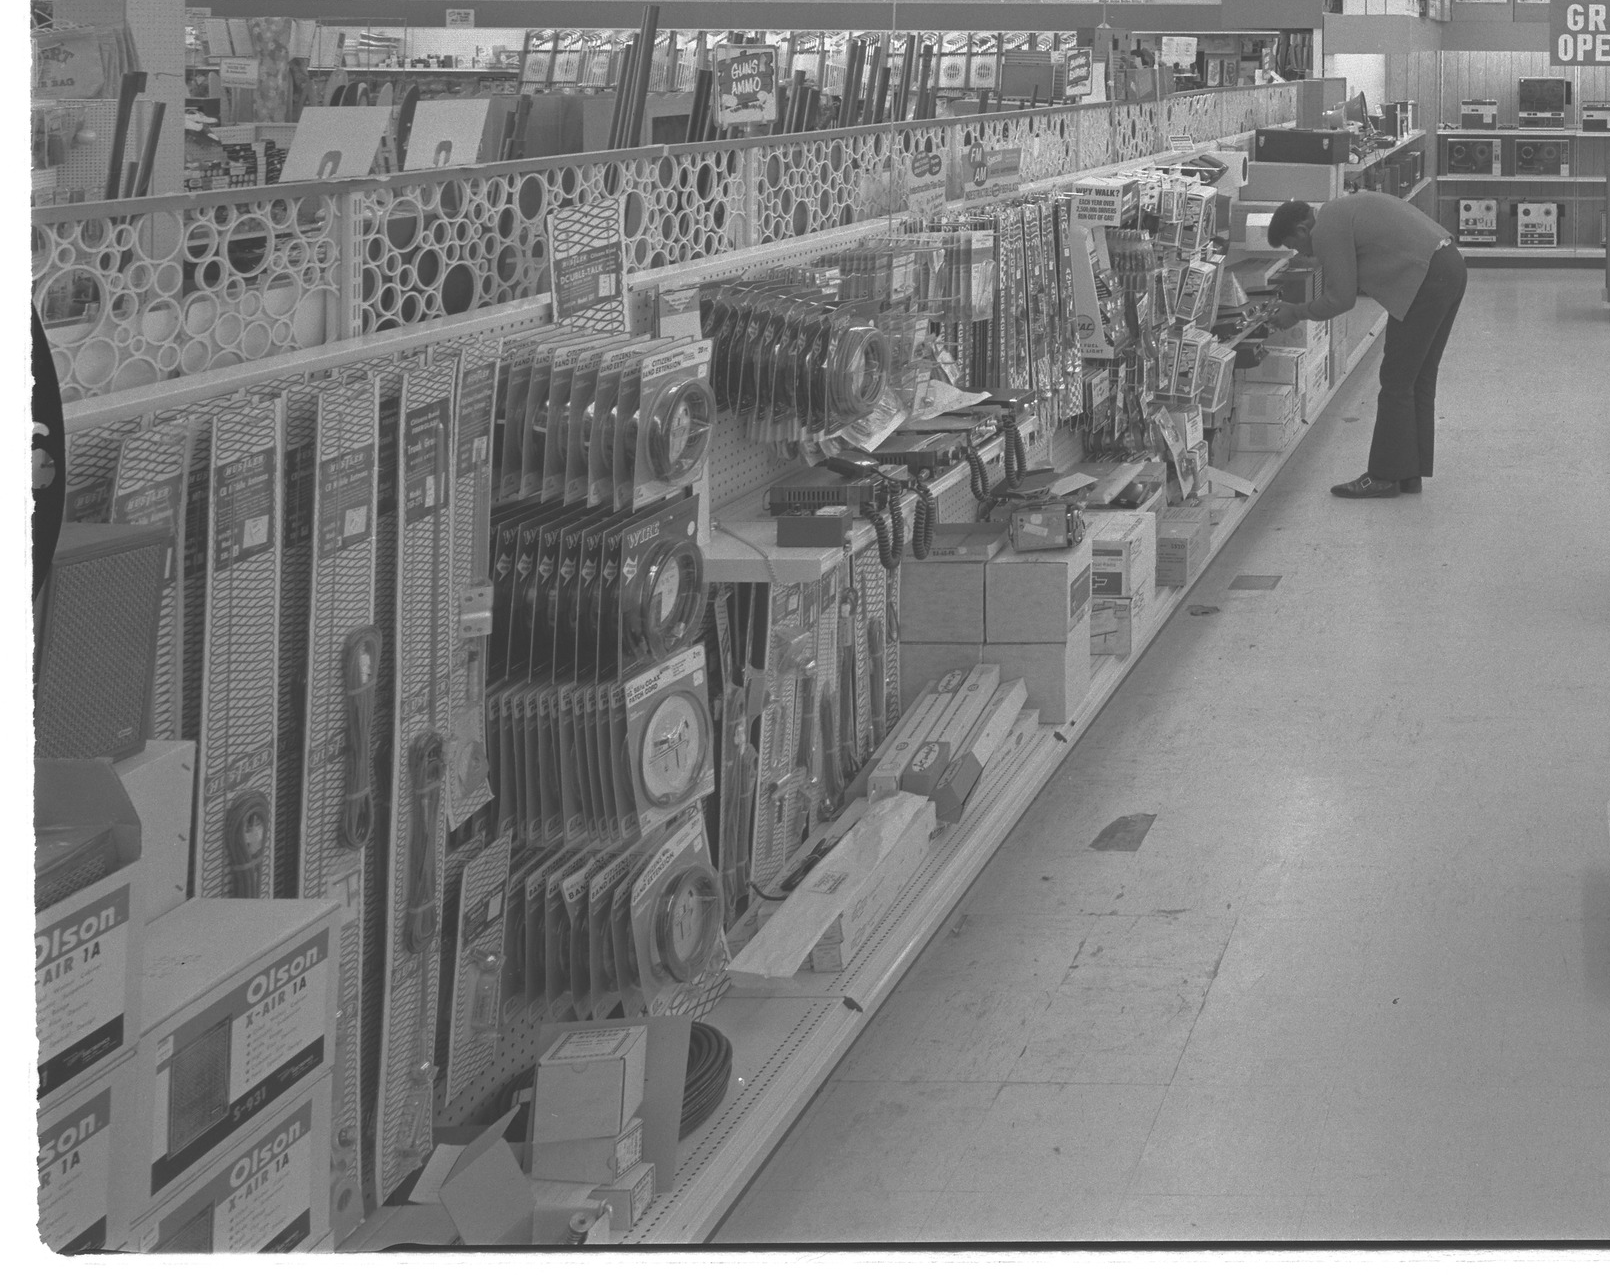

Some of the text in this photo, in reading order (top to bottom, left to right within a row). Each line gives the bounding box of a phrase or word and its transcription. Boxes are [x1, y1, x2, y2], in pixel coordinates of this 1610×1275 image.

[731, 59, 759, 79] GUNS
[731, 76, 761, 95] AMMO
[970, 147, 983, 163] FM
[974, 166, 987, 182] AM
[1075, 187, 1120, 198] WHY WALK?
[651, 357, 672, 368] CITIZENS
[655, 360, 681, 375] EXTENSION
[627, 521, 660, 549] WIRE
[83, 941, 100, 964] 1A
[247, 945, 319, 1005] Olson
[246, 976, 307, 1029] X-AIR 1A
[233, 1086, 267, 1123] S-931
[229, 1123, 301, 1188] Olson
[228, 1151, 289, 1213] X-AIR 1A
